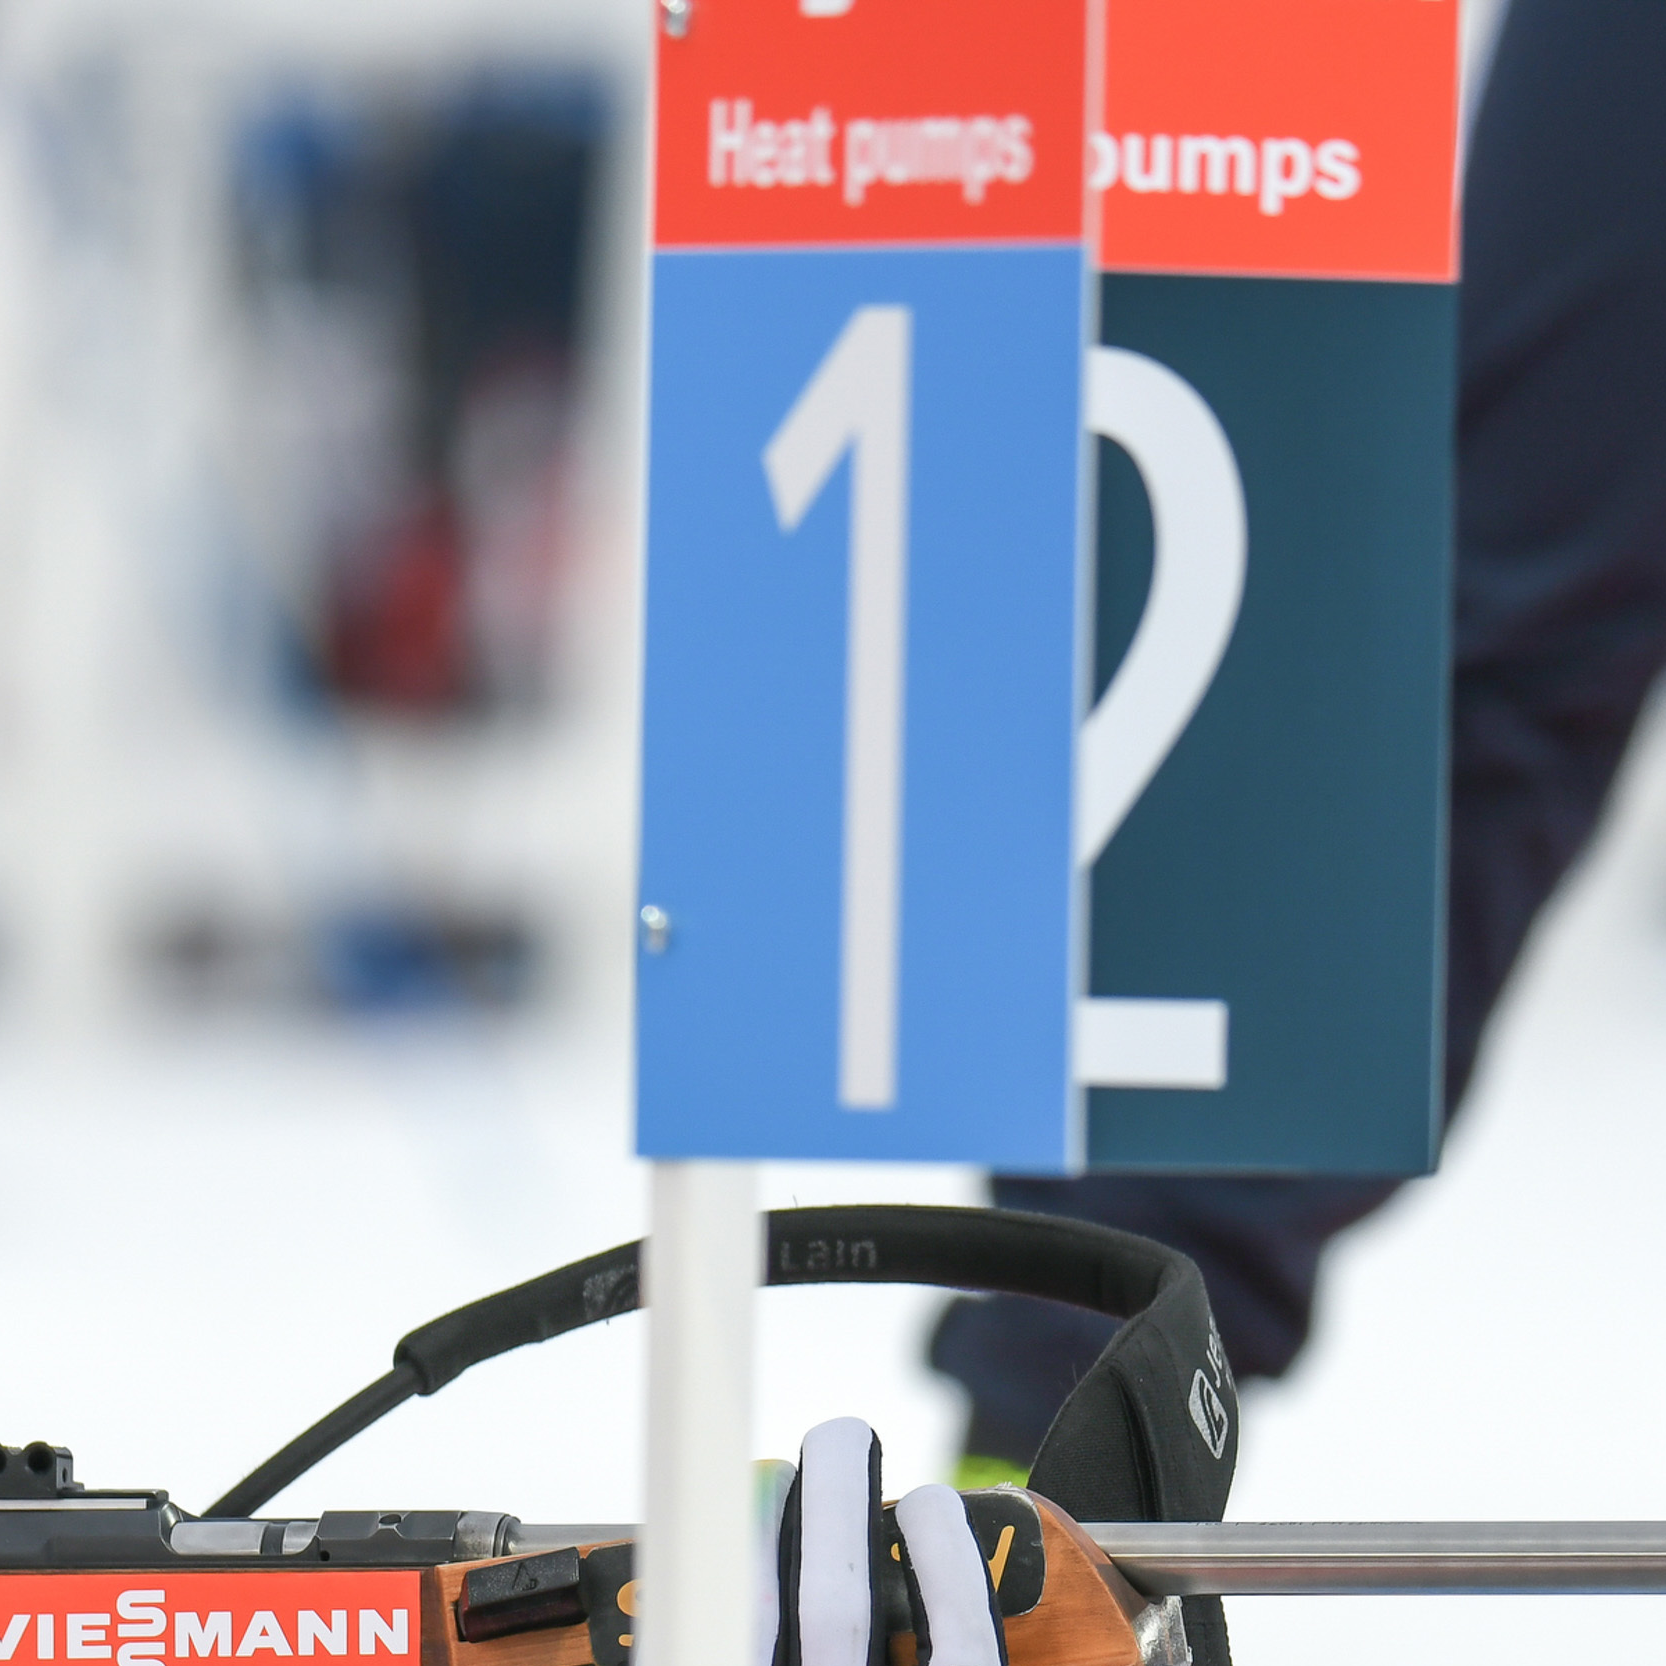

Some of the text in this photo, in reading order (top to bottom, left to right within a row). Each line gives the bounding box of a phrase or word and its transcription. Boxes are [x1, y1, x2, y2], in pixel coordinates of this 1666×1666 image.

[709, 98, 1034, 206] Heat pumps
[762, 305, 911, 1110] 1
[1073, 344, 1249, 1090] 2
